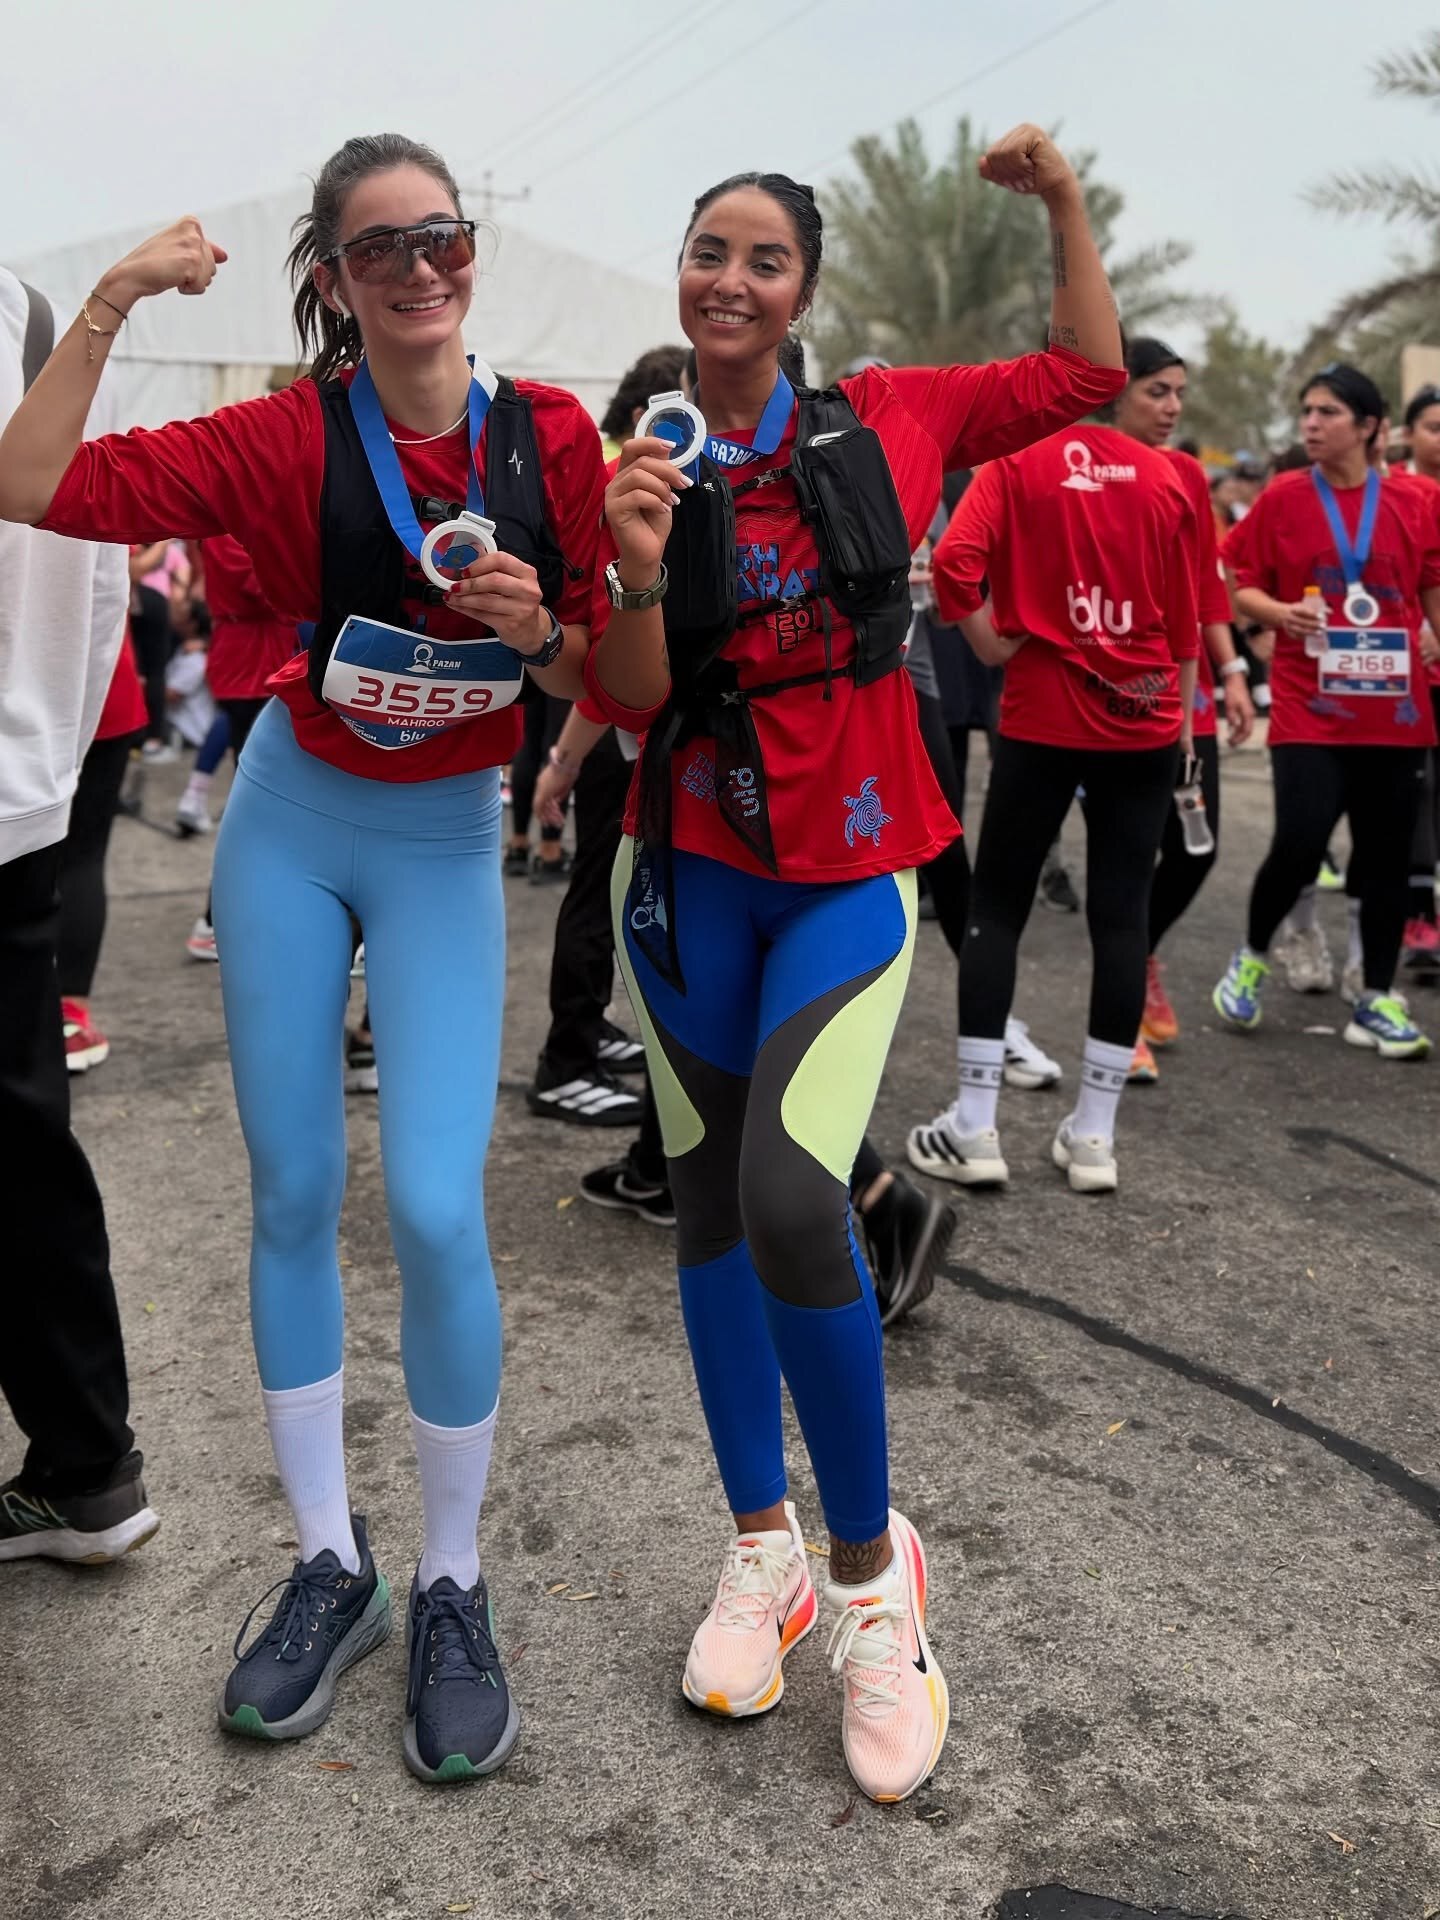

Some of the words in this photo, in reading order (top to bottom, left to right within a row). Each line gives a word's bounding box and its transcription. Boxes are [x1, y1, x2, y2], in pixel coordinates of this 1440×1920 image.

[710, 440, 754, 465] PAZAN
[1093, 463, 1137, 478] PAZAN
[1066, 580, 1133, 635] blu
[778, 610, 810, 631] 20
[432, 658, 461, 668] PAZAN
[1338, 655, 1395, 672] 2168
[350, 675, 493, 715] 3559
[387, 717, 445, 727] MAHROO
[400, 729, 425, 742] blu
